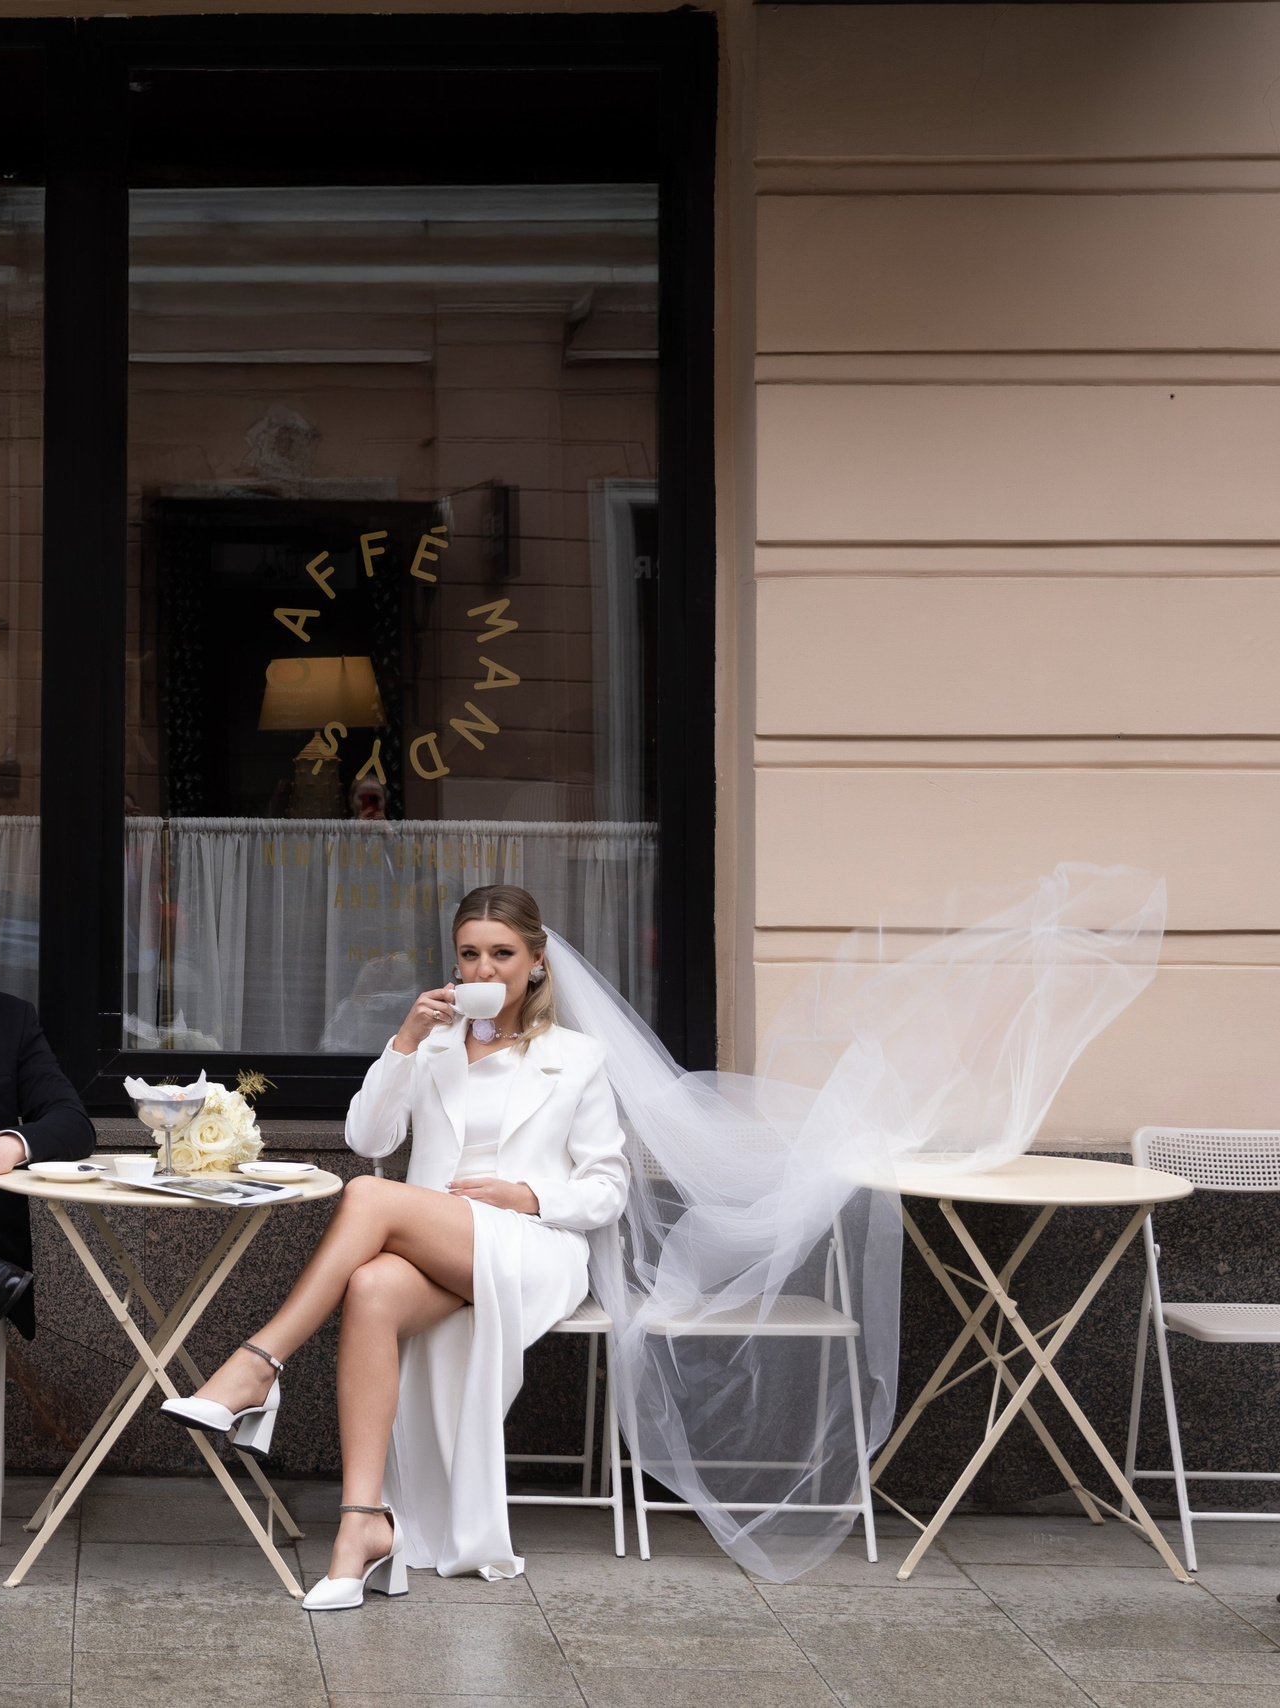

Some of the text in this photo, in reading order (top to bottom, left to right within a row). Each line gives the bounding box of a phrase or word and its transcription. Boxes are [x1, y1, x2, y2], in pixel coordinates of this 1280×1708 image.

[264, 840, 521, 869] NEW YORK BRASSERIE
[334, 882, 449, 911] AND SHOP
[348, 946, 435, 963] MMXXI
